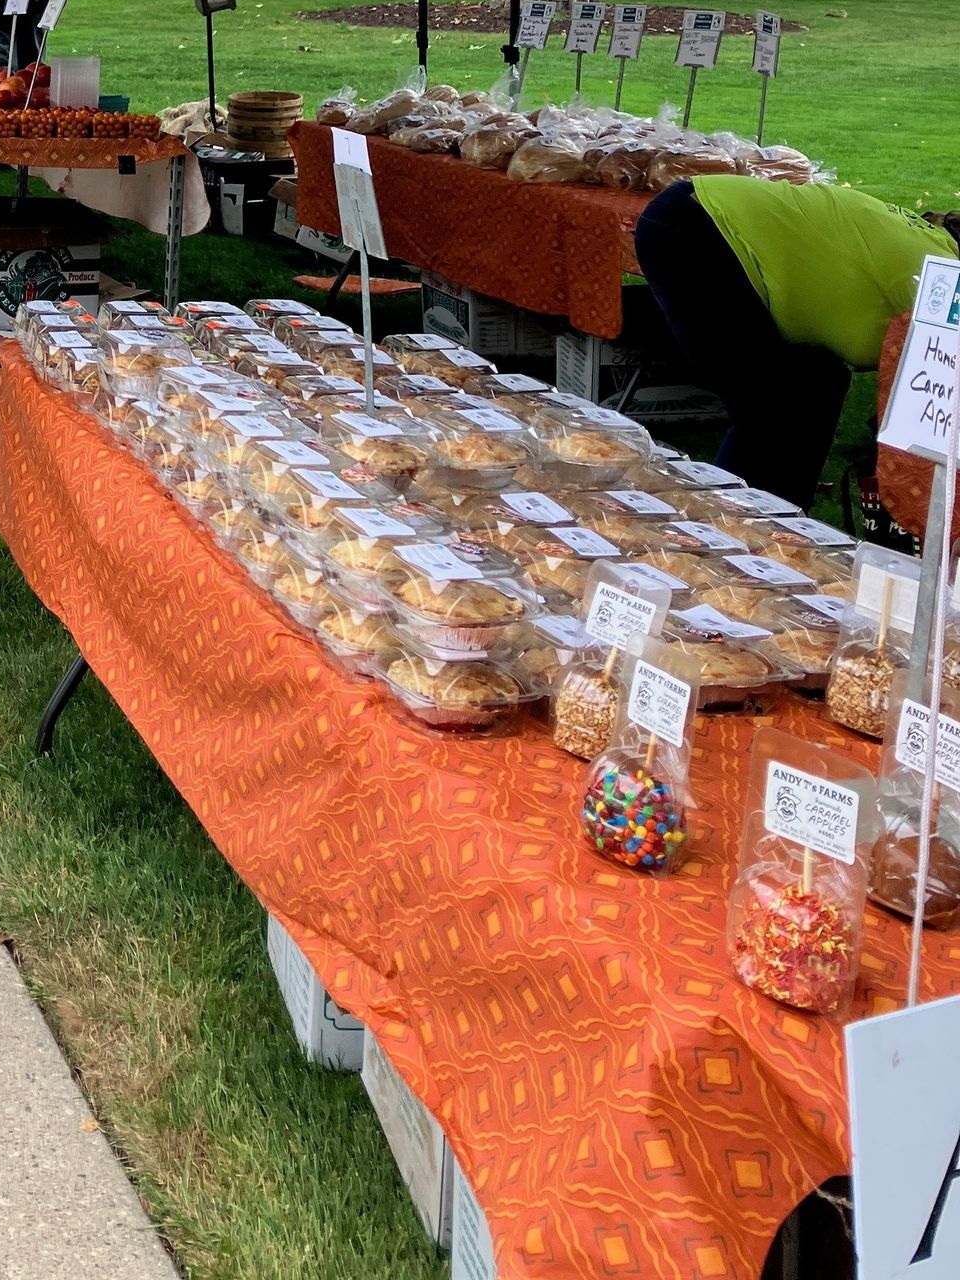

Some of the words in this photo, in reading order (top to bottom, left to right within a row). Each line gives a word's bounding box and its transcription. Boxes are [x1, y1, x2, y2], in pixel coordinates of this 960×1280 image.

[68, 272, 95, 282] Produce
[600, 588, 620, 601] ANDY
[638, 666, 656, 680] ANDY
[906, 706, 931, 723] ANDY
[773, 769, 802, 786] ANDY
[803, 779, 817, 792] T's
[819, 785, 853, 806] FARMS
[804, 803, 852, 827] CARAMEL
[808, 815, 846, 836] APPLES
